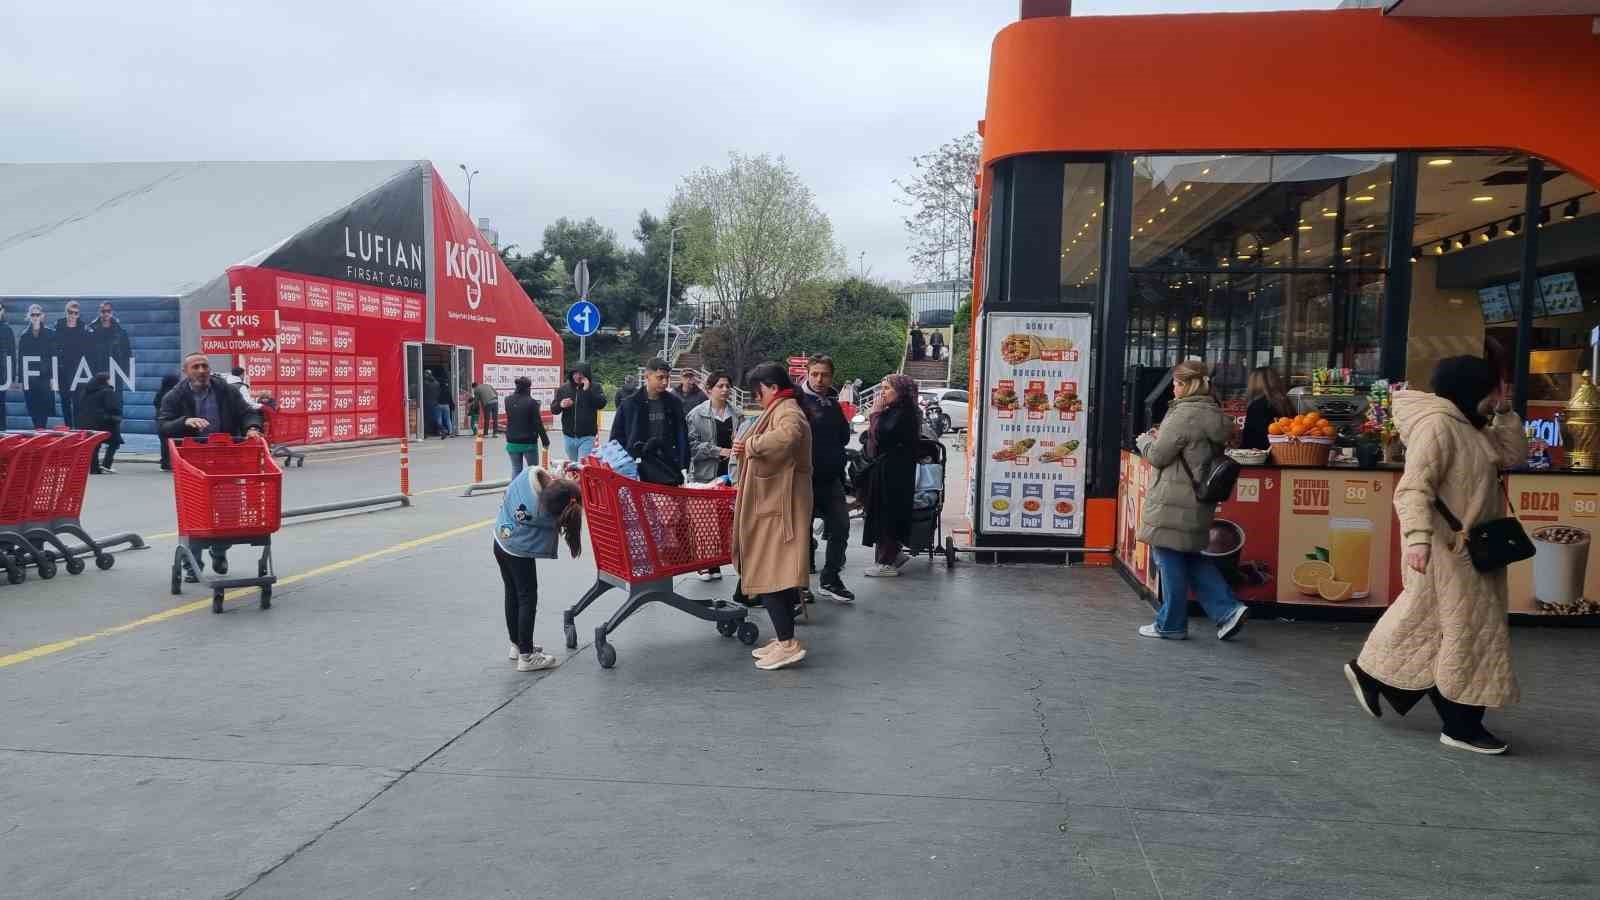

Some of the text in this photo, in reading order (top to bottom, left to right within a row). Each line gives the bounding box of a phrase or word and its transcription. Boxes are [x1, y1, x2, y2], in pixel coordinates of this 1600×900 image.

[345, 226, 422, 272] LUFIAN
[346, 265, 384, 283] FIRSAT
[227, 314, 260, 327] ÇIKIŞ
[496, 339, 525, 354] BÜYÜK
[1239, 483, 1258, 497] 70
[1293, 489, 1330, 506] SUYU
[1345, 486, 1367, 500] 80
[1520, 491, 1560, 511] BOZA
[1575, 499, 1597, 513] 80
